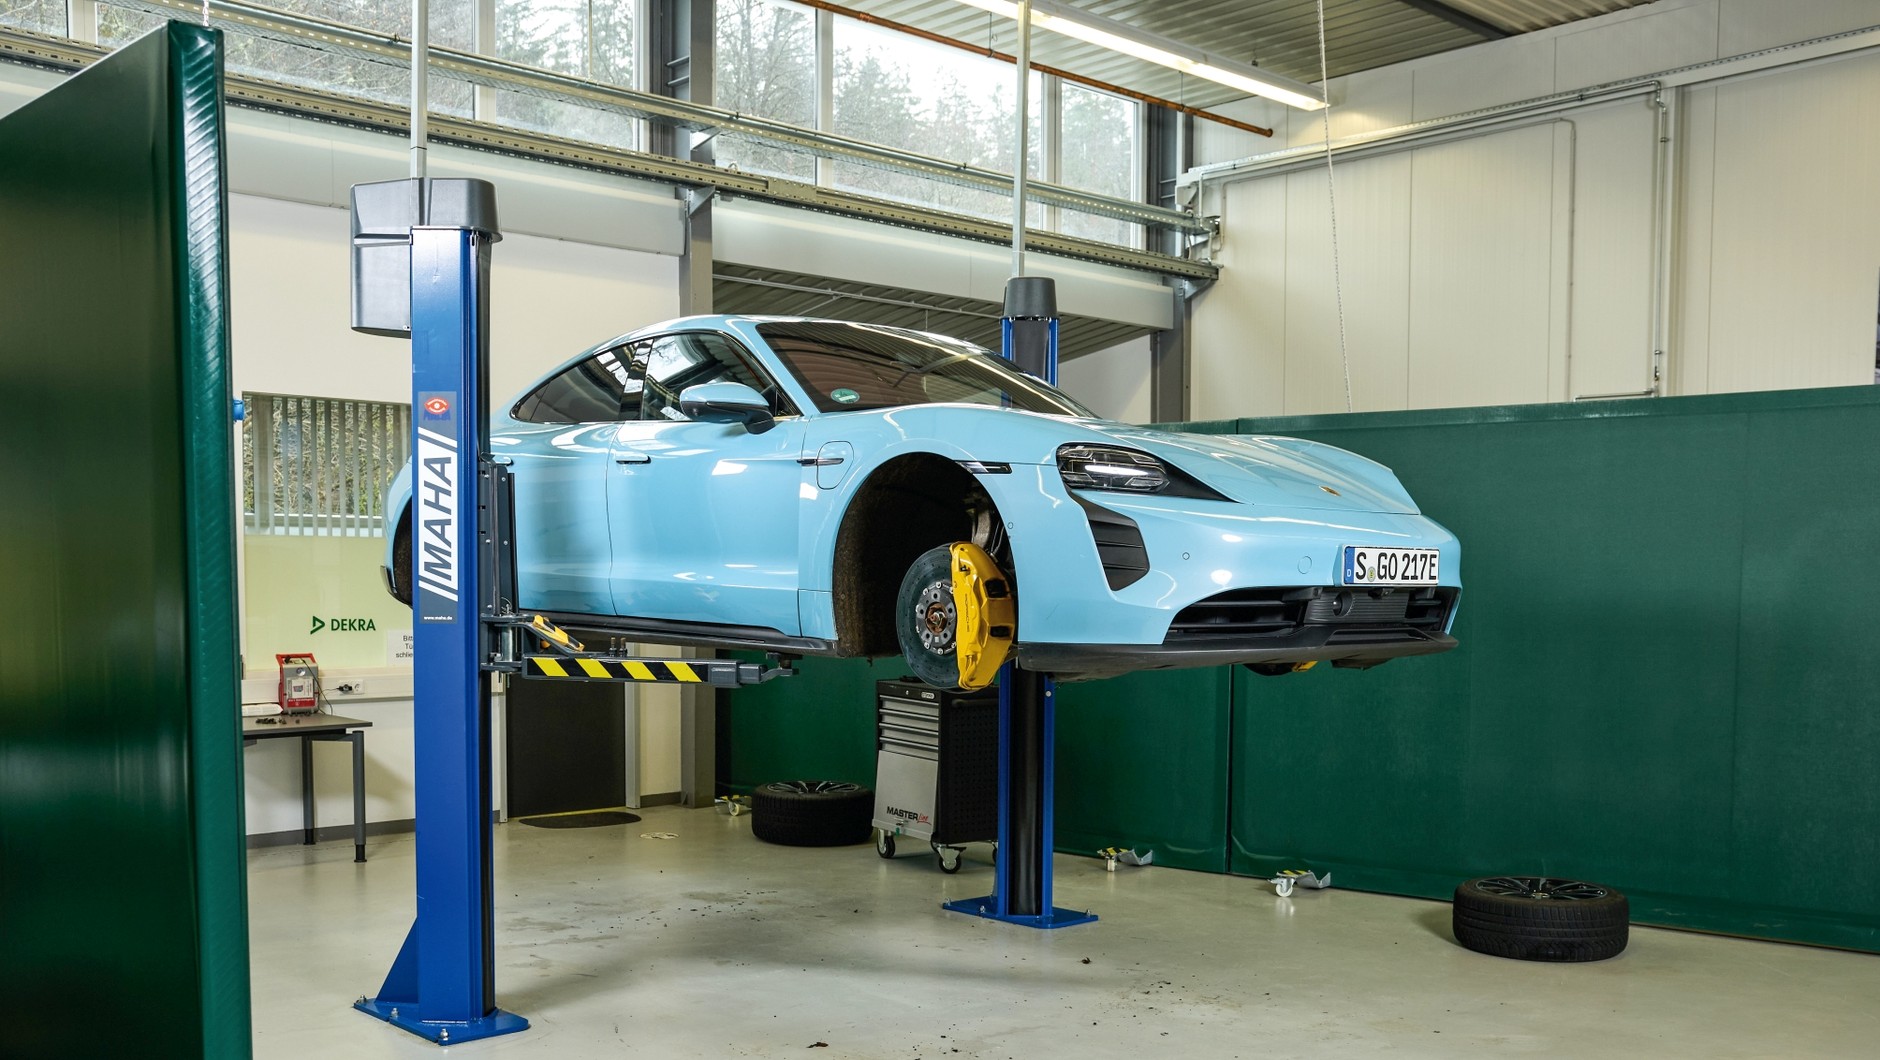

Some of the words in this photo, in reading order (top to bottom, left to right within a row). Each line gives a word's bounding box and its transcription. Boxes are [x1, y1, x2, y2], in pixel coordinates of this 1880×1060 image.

[424, 457, 452, 582] MAHA
[1346, 568, 1352, 577] D
[1355, 551, 1367, 580] S
[1377, 552, 1398, 580] GO
[1401, 553, 1437, 580] 217E
[330, 618, 377, 632] DEKRA
[886, 806, 918, 821] MASTER
